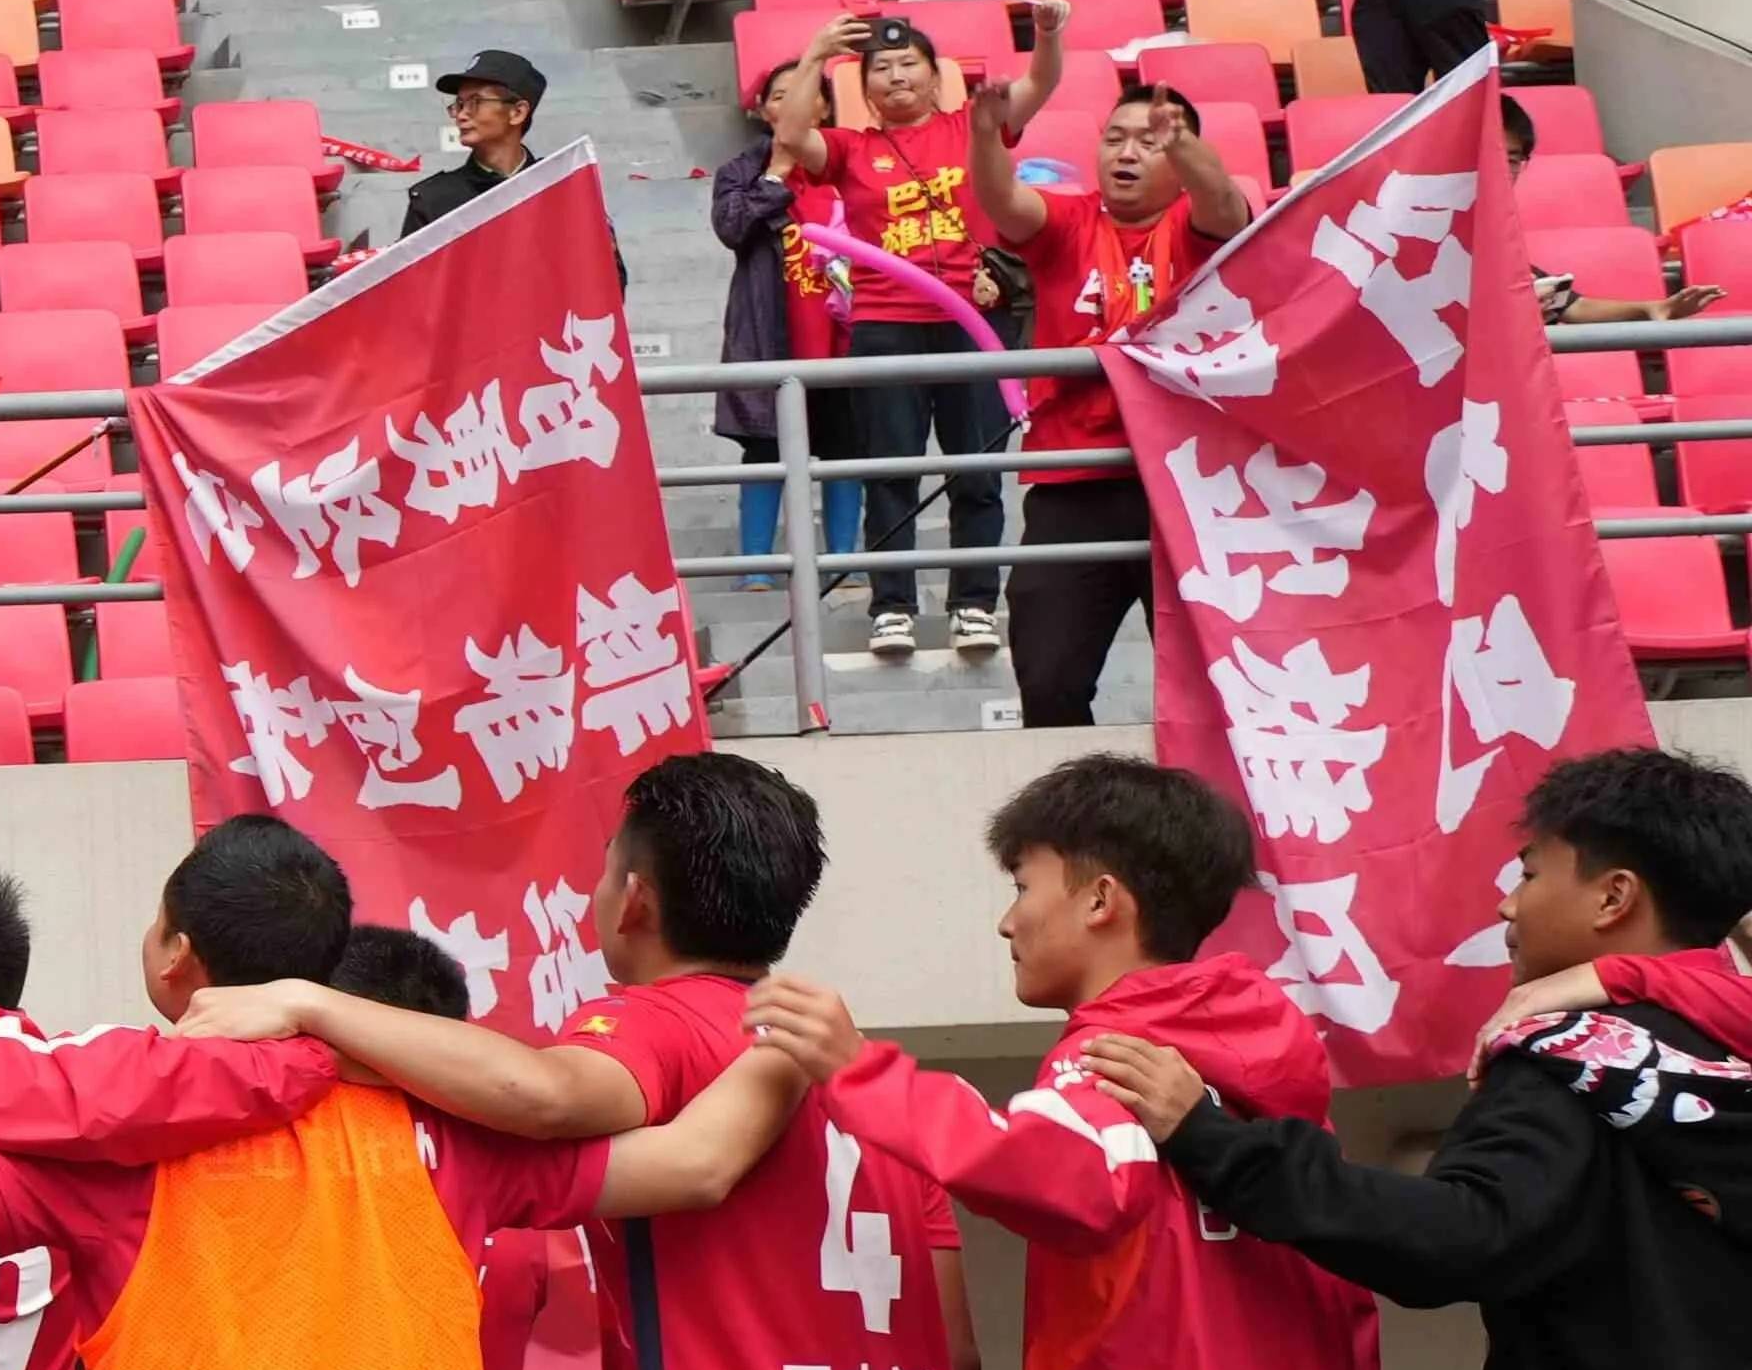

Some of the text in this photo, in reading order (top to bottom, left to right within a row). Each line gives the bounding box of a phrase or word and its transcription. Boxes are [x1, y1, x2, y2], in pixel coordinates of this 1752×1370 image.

[881, 207, 965, 256] 雄起
[886, 166, 965, 215] 巴中
[219, 571, 694, 812] 排难创新
[819, 1117, 901, 1335] 4
